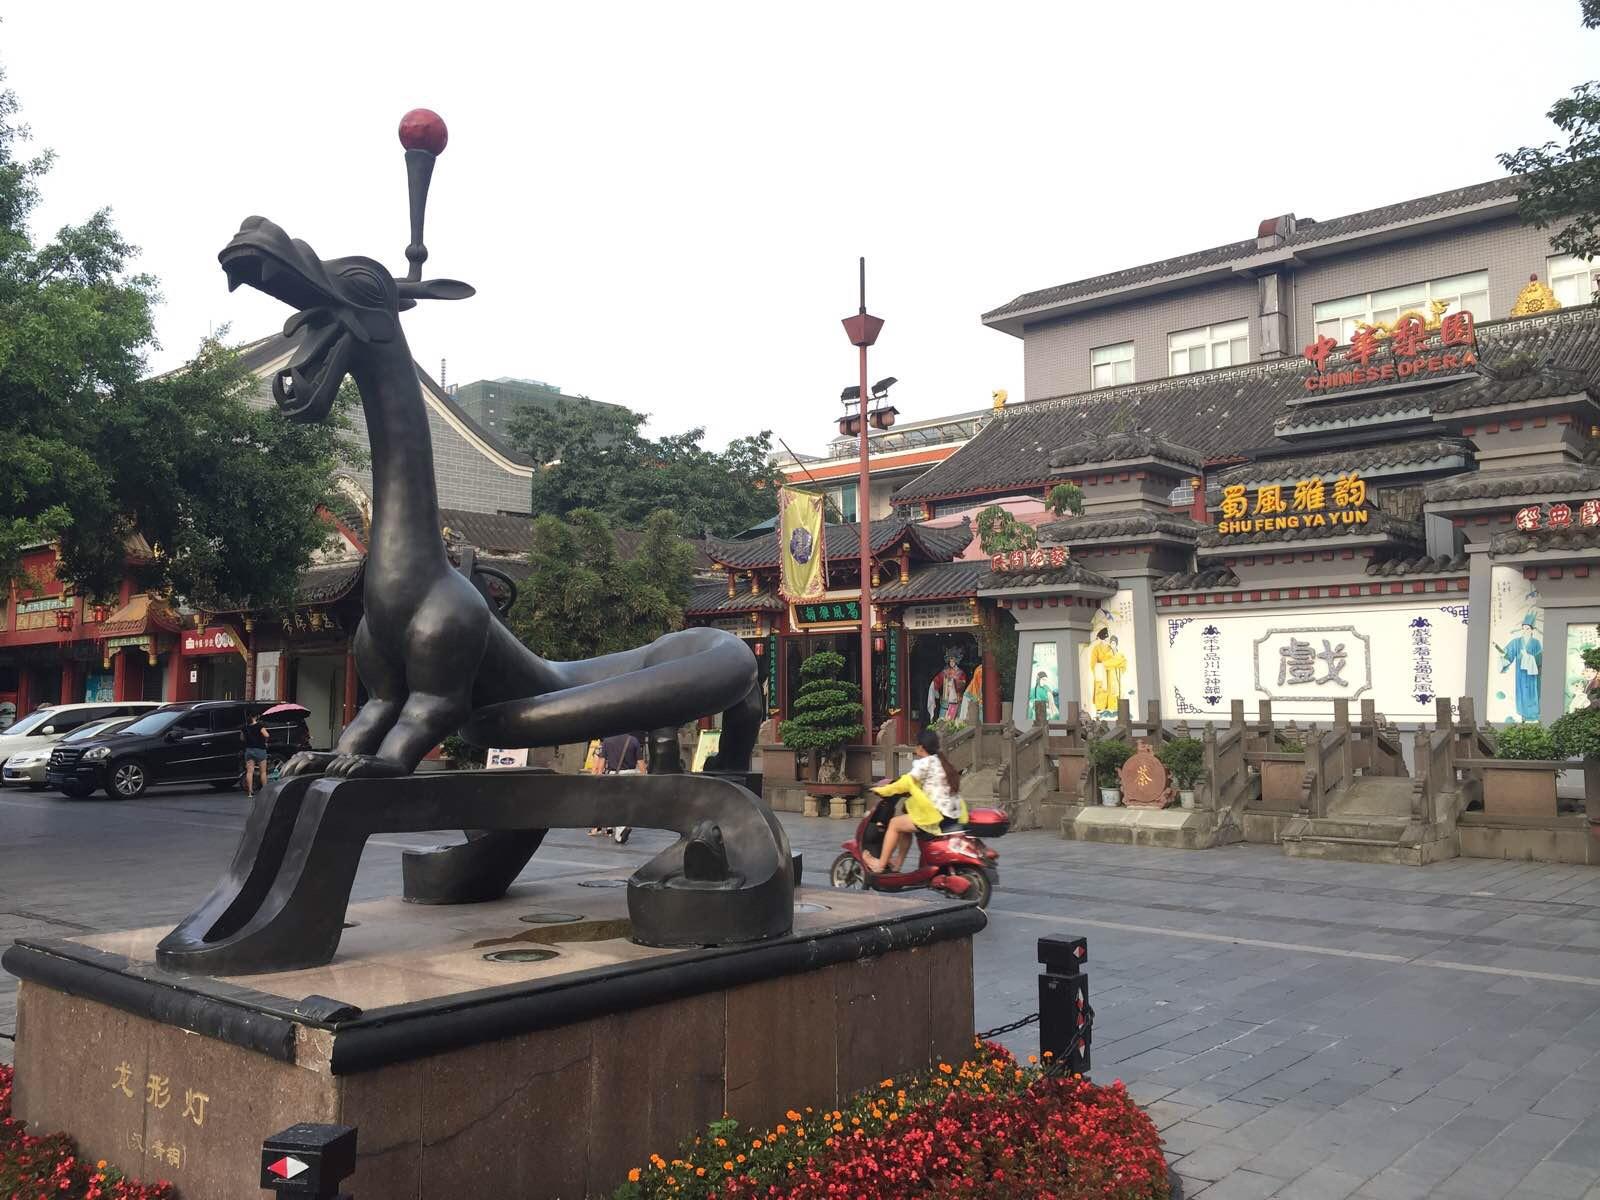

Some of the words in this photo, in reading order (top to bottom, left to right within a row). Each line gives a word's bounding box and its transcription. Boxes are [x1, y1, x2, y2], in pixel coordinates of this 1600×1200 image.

[1305, 363, 1393, 391] CHINESE
[1398, 352, 1477, 377] OPERA
[1218, 520, 1252, 534] SHU
[1255, 516, 1299, 531] FENG
[1302, 514, 1326, 527] YA
[1328, 510, 1368, 525] YUN
[111, 1060, 209, 1127] 龙形灯
